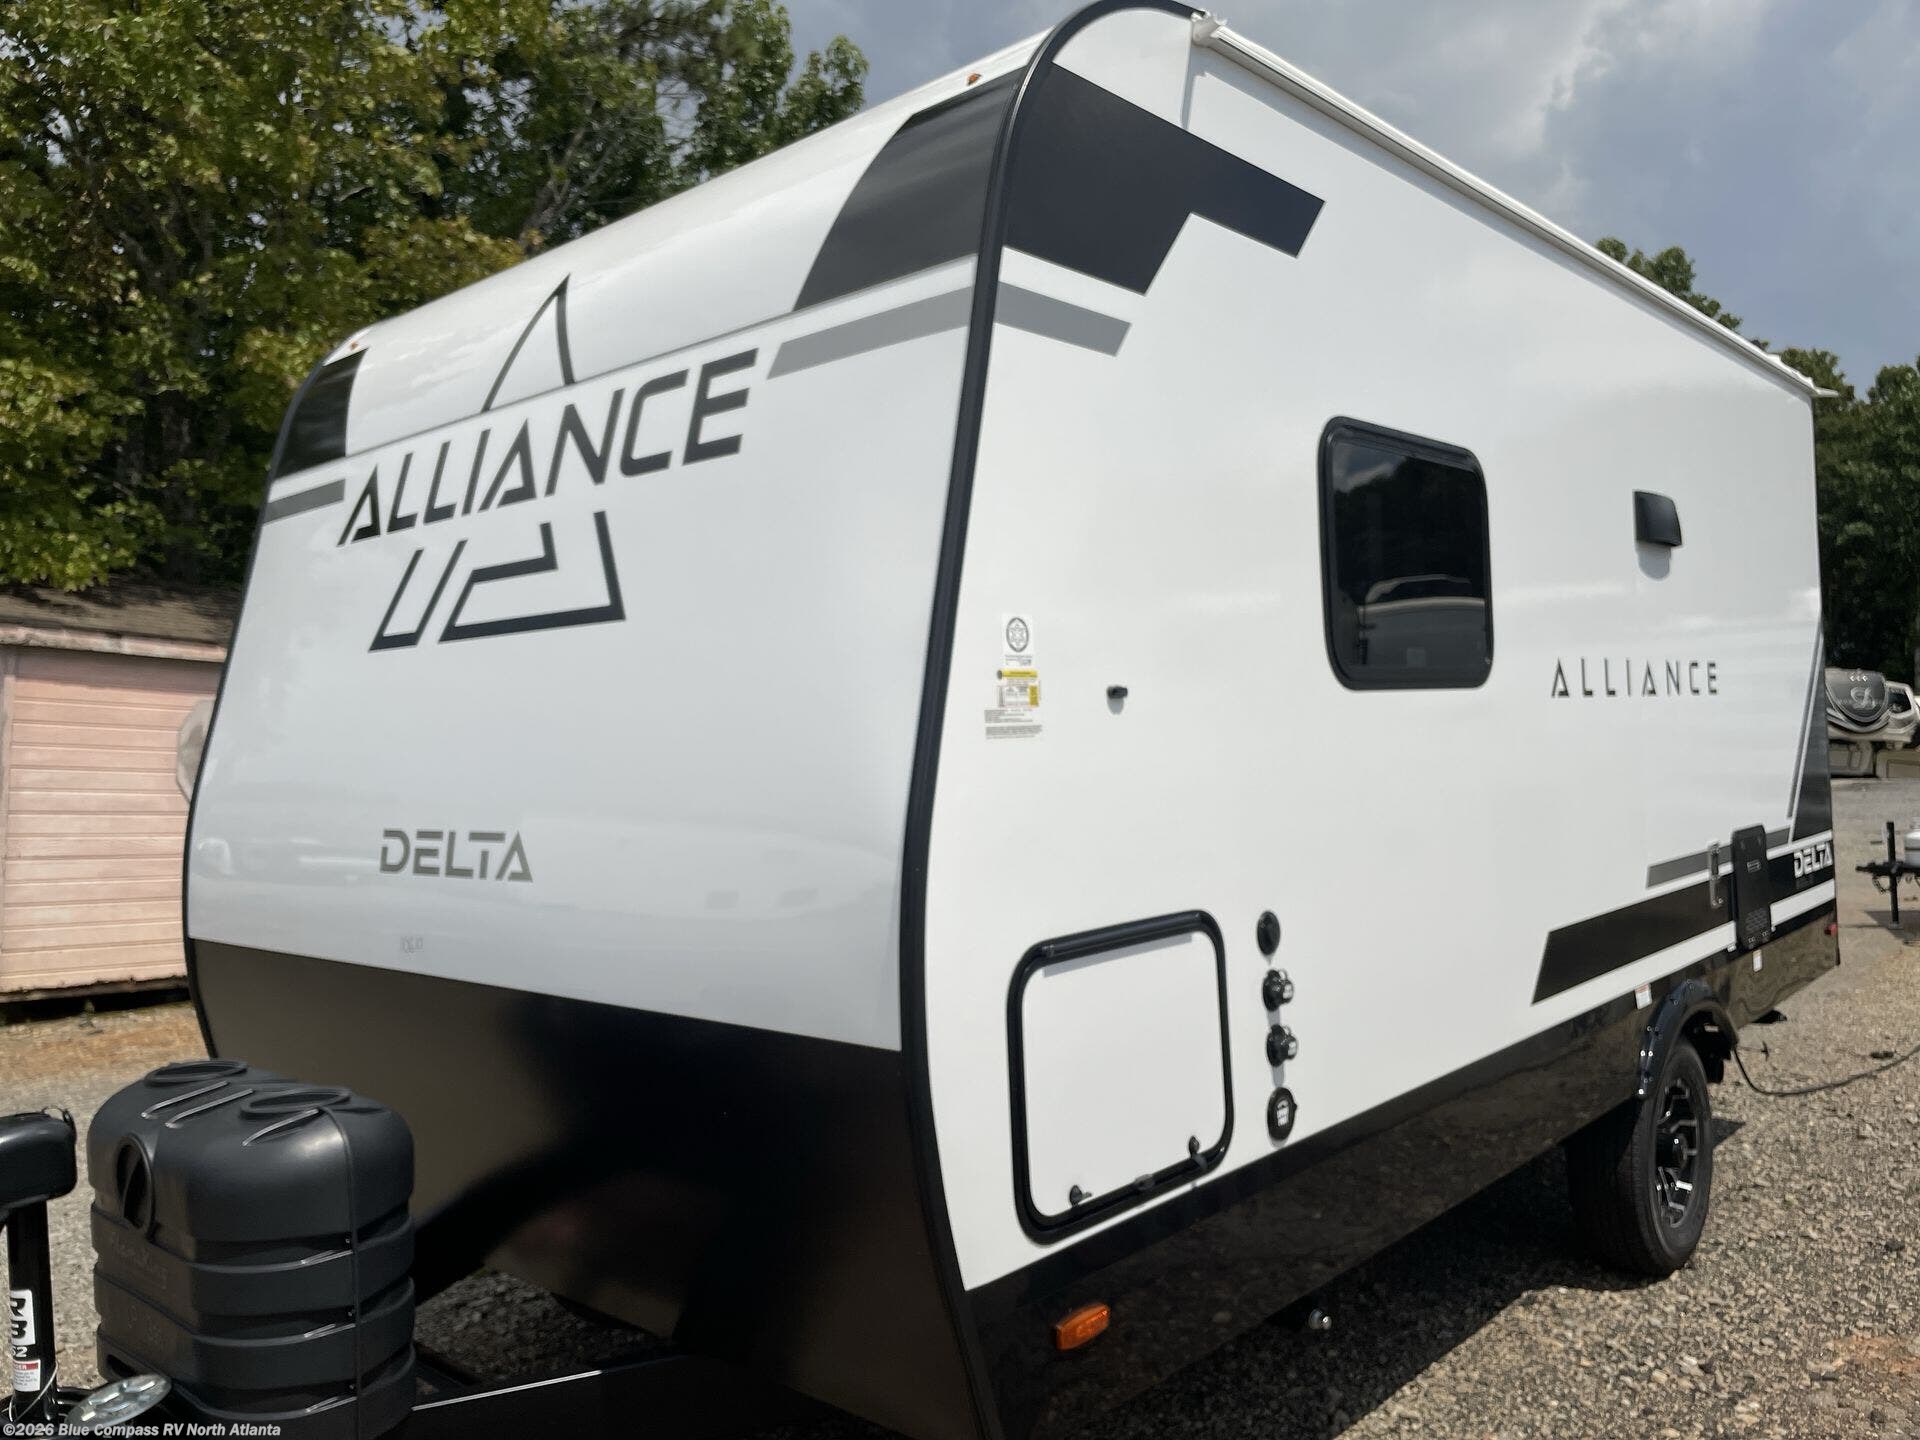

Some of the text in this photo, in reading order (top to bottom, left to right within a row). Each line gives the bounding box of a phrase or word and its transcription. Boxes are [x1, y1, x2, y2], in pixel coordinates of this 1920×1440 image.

[337, 348, 759, 547] ALLIANCE
[1551, 656, 1719, 697] ALLIANCE
[379, 828, 533, 883] DELTA
[1793, 842, 1833, 878] DELTA
